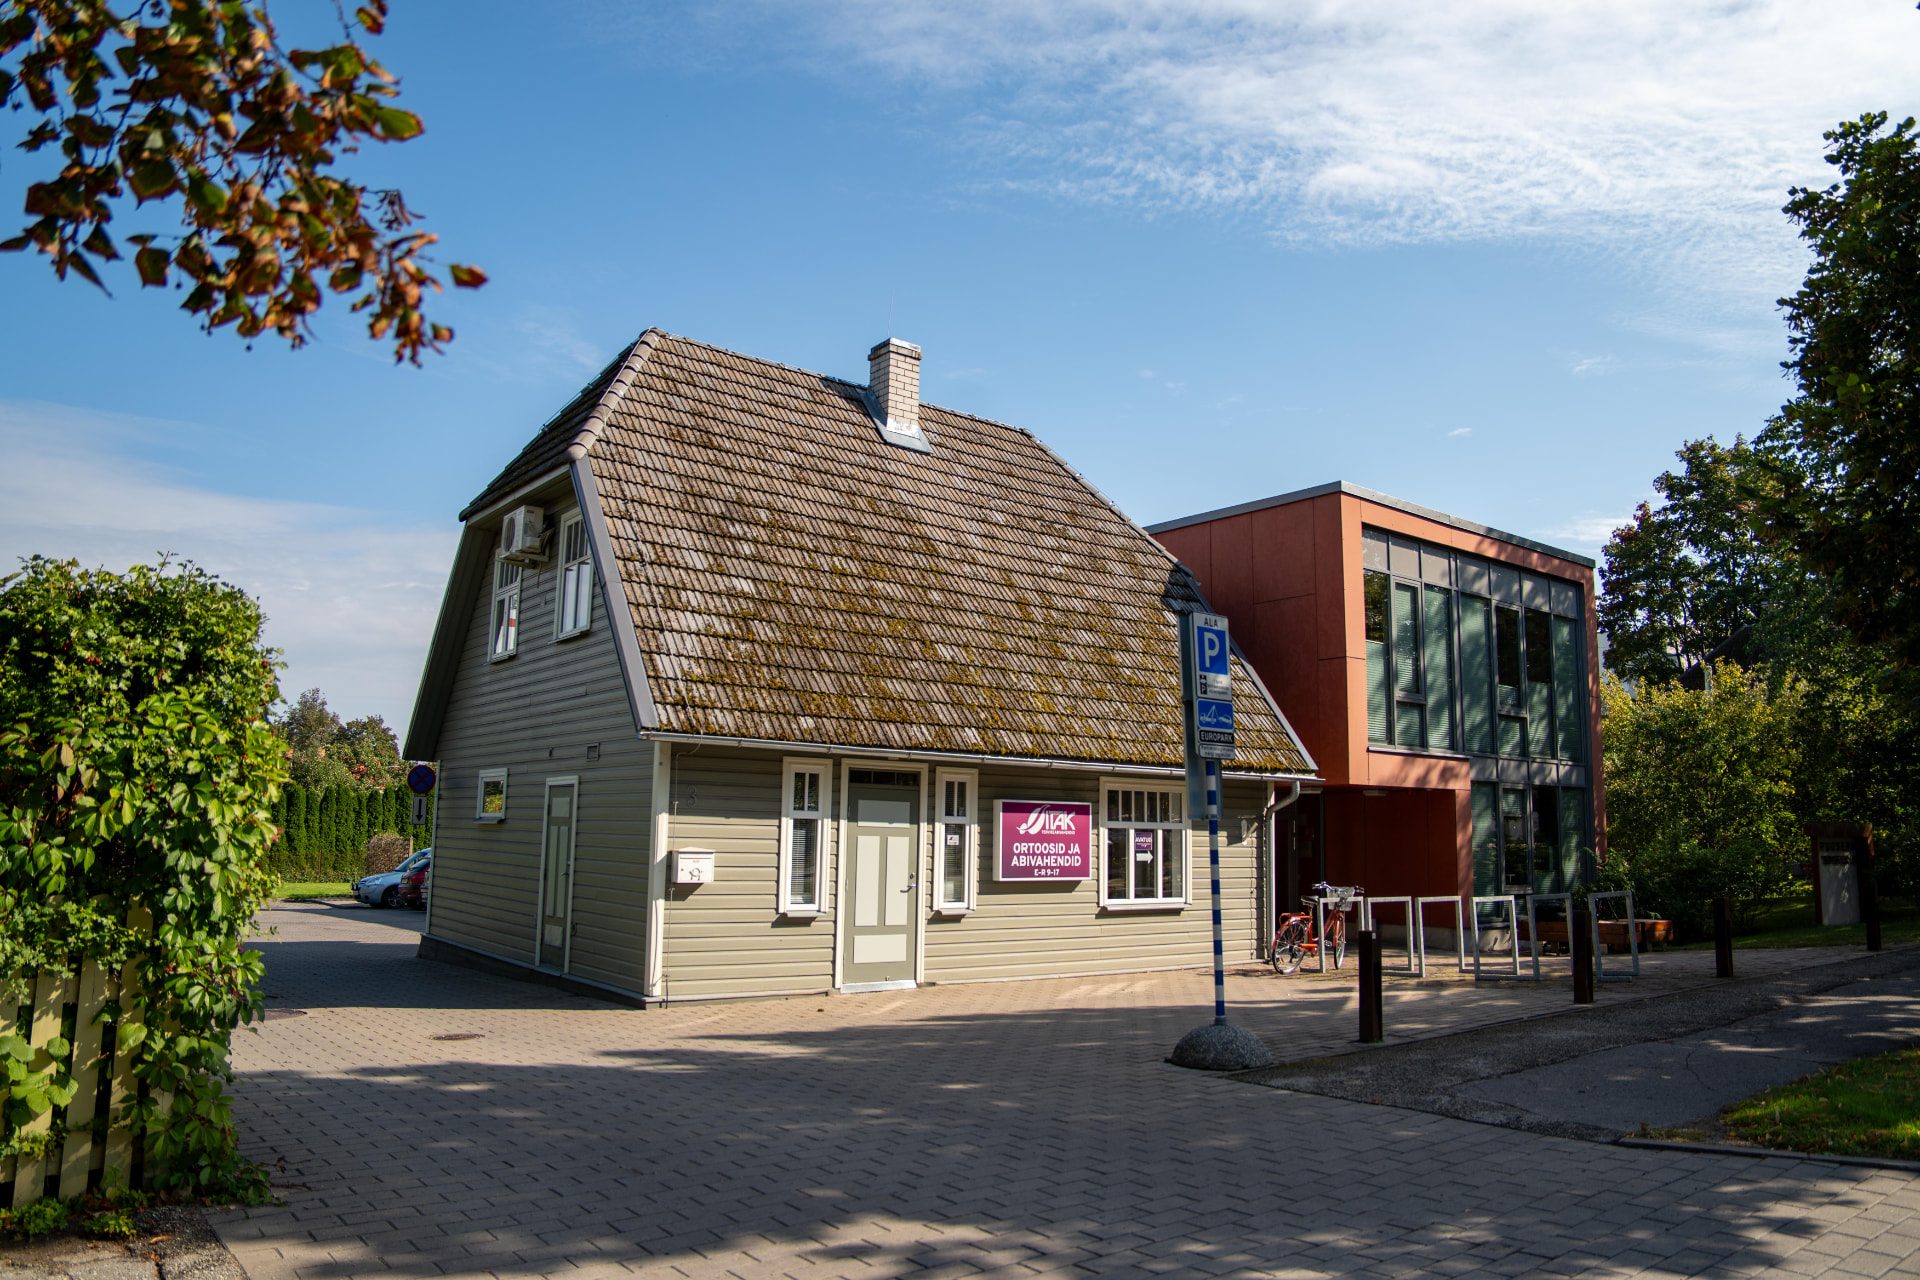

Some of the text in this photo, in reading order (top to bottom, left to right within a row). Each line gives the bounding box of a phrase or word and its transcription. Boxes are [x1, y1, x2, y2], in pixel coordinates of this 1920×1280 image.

[1203, 617, 1219, 628] ALA
[1203, 631, 1220, 668] P
[1200, 731, 1233, 743] EUROPARK
[1013, 842, 1081, 854] ORTOOSID JA
[1011, 855, 1082, 867] ABIVAHENDID
[1034, 868, 1060, 876] E-R 9-17
